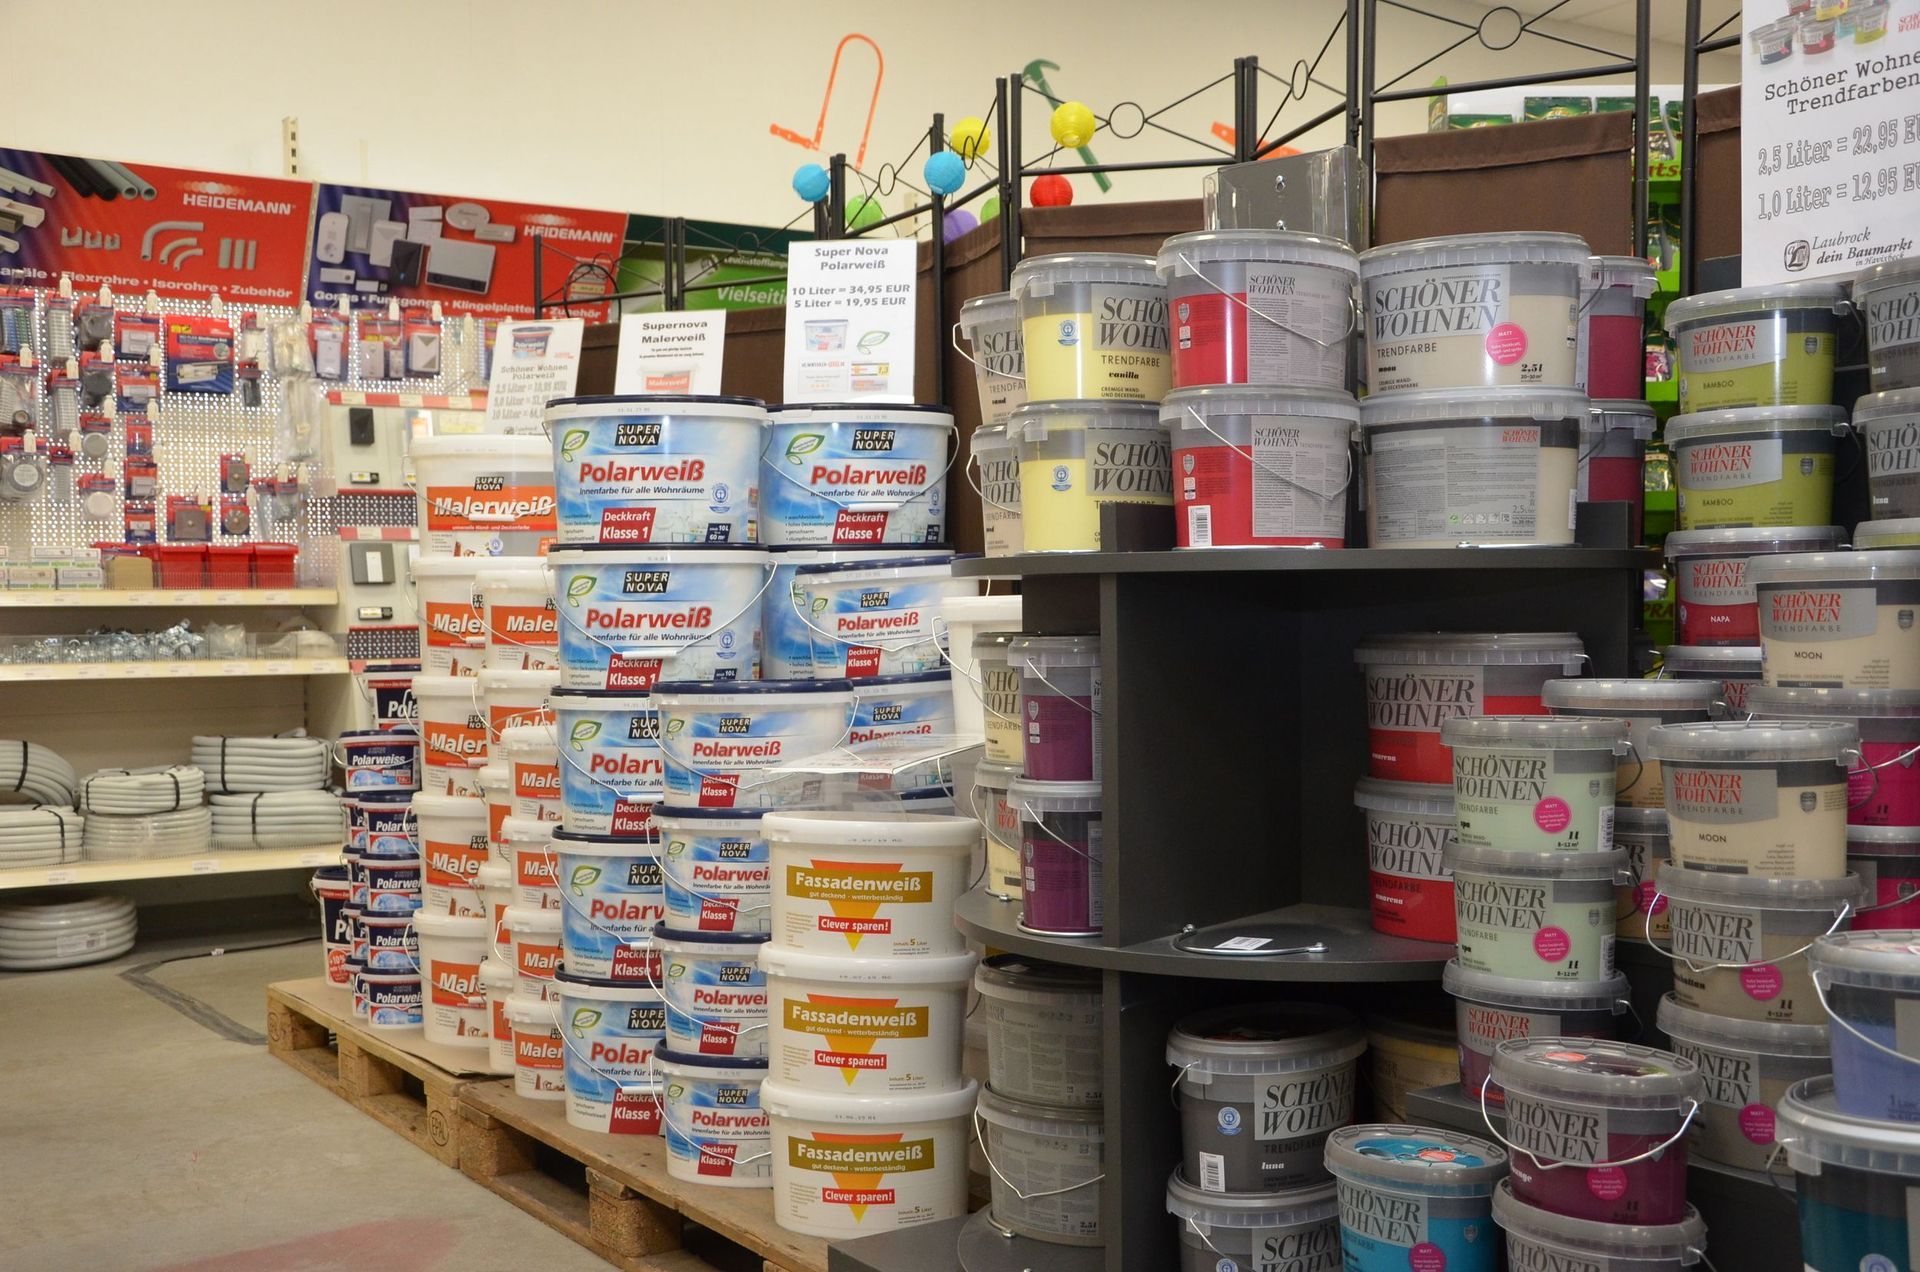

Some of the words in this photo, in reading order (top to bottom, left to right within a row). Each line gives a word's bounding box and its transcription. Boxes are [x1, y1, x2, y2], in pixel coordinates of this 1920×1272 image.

[1765, 69, 1848, 101] Schöner
[1758, 145, 1781, 176] 2,5
[1787, 140, 1832, 169] Liter
[1837, 137, 1847, 151] =
[1853, 119, 1898, 155] 22,95
[1758, 190, 1781, 220] 1,0
[1786, 185, 1832, 214] Liter
[1837, 184, 1847, 198] =
[1853, 167, 1897, 201] 12,95
[182, 193, 292, 216] HEIDEMANN
[523, 225, 614, 244] HEIDEMANN
[1812, 227, 1871, 250] Laubrock
[814, 247, 851, 258] Super
[855, 247, 889, 256] Nova
[1817, 252, 1842, 265] dein
[1847, 238, 1913, 260] Baumarkt
[820, 261, 886, 271] Polarweiß
[1249, 275, 1295, 286] SCHÖNER
[152, 280, 219, 293] Isorohre
[230, 284, 293, 298] Zubehör
[792, 287, 805, 295] 10
[809, 286, 836, 295] Liter
[849, 285, 882, 295] 34,95
[886, 284, 910, 293] EUR
[1249, 285, 1295, 295] WOHNEN
[717, 286, 787, 304] Vielseiti
[1375, 278, 1501, 314] SCHÖNER
[805, 299, 831, 308] Liter
[846, 298, 878, 307] 19,95
[882, 297, 906, 306] EUR
[549, 307, 602, 319] Zubehör
[643, 321, 708, 331] Supernova
[1376, 305, 1500, 340] WOHNEN
[641, 333, 706, 344] Malerweiß
[1693, 324, 1756, 344] SCHÖNER
[1377, 343, 1437, 358] TRENDFARBE
[1693, 337, 1755, 357] WOHNEN
[1101, 355, 1160, 367] TRENDFARBE
[1109, 371, 1139, 379] vanilla
[1703, 379, 1734, 390] BAMBOO
[618, 425, 661, 435] SUPER
[855, 431, 894, 440] SUPER
[1255, 426, 1300, 437] SCHÖNER
[618, 435, 656, 445] NOVA
[1254, 437, 1299, 447] WOHNEN
[1503, 435, 1537, 443] WOHNEN
[855, 441, 890, 450] NOVA
[1690, 445, 1752, 462] SCHÖNER
[579, 460, 705, 483] Polarweiß
[1690, 457, 1751, 475] WOHNEN
[811, 465, 927, 486] Polarweiß
[580, 487, 619, 496] Innenfarbe
[621, 487, 634, 495] für
[653, 486, 704, 494] Wohnräume
[434, 495, 551, 516] Malerweiß
[1703, 498, 1734, 507] BAMBOO
[604, 512, 651, 522] Deckkraft
[839, 513, 884, 523] Deckkraft
[603, 527, 639, 539] Klasse
[642, 527, 648, 539] 1
[836, 528, 873, 539] Klasse
[876, 528, 882, 539] 1
[626, 572, 669, 582] SUPER
[626, 583, 664, 592] NOVA
[862, 592, 889, 600] SUPER
[1773, 591, 1841, 608] SCHÖNER
[862, 599, 887, 607] NOVA
[585, 607, 712, 629] Polarweiß
[1710, 615, 1730, 623] NAPA
[1772, 608, 1840, 623] WOHNEN
[837, 612, 919, 631] Polarweiß
[1773, 624, 1841, 633] TRENDFARBE
[848, 648, 880, 656] Deckkraft
[1794, 651, 1822, 660] MOON
[611, 658, 659, 668] Deckkraft
[848, 659, 872, 667] Klasse
[609, 673, 646, 686] Klasse
[1369, 673, 1475, 703] SCHÖNER
[874, 706, 901, 715] SUPER
[720, 718, 750, 726] SUPER
[693, 741, 781, 757] Polarweiß
[352, 755, 406, 766] Polarweiss
[1456, 754, 1547, 780] SCHÖNER
[1674, 770, 1743, 789] SCHÖNER
[702, 787, 728, 796] Klasse
[1456, 776, 1547, 800] WOHNEN
[1675, 787, 1743, 805] WOHNEN
[1677, 804, 1744, 815] TRENDFARBE
[1699, 834, 1727, 843] MOON
[796, 872, 921, 891] Fassadenweiß
[852, 894, 903, 902] wetterbeständig
[821, 918, 849, 930] Clever
[852, 921, 889, 932] sparen!
[792, 1006, 917, 1027] Fassadenweiß
[817, 1053, 845, 1064] Clever
[848, 1056, 884, 1067] sparen!
[797, 1144, 923, 1163] Fassadenweiß
[701, 1156, 726, 1165] Klasse
[1261, 1162, 1284, 1170] luna
[825, 1190, 853, 1201] Clever
[856, 1192, 892, 1204] sparen!
